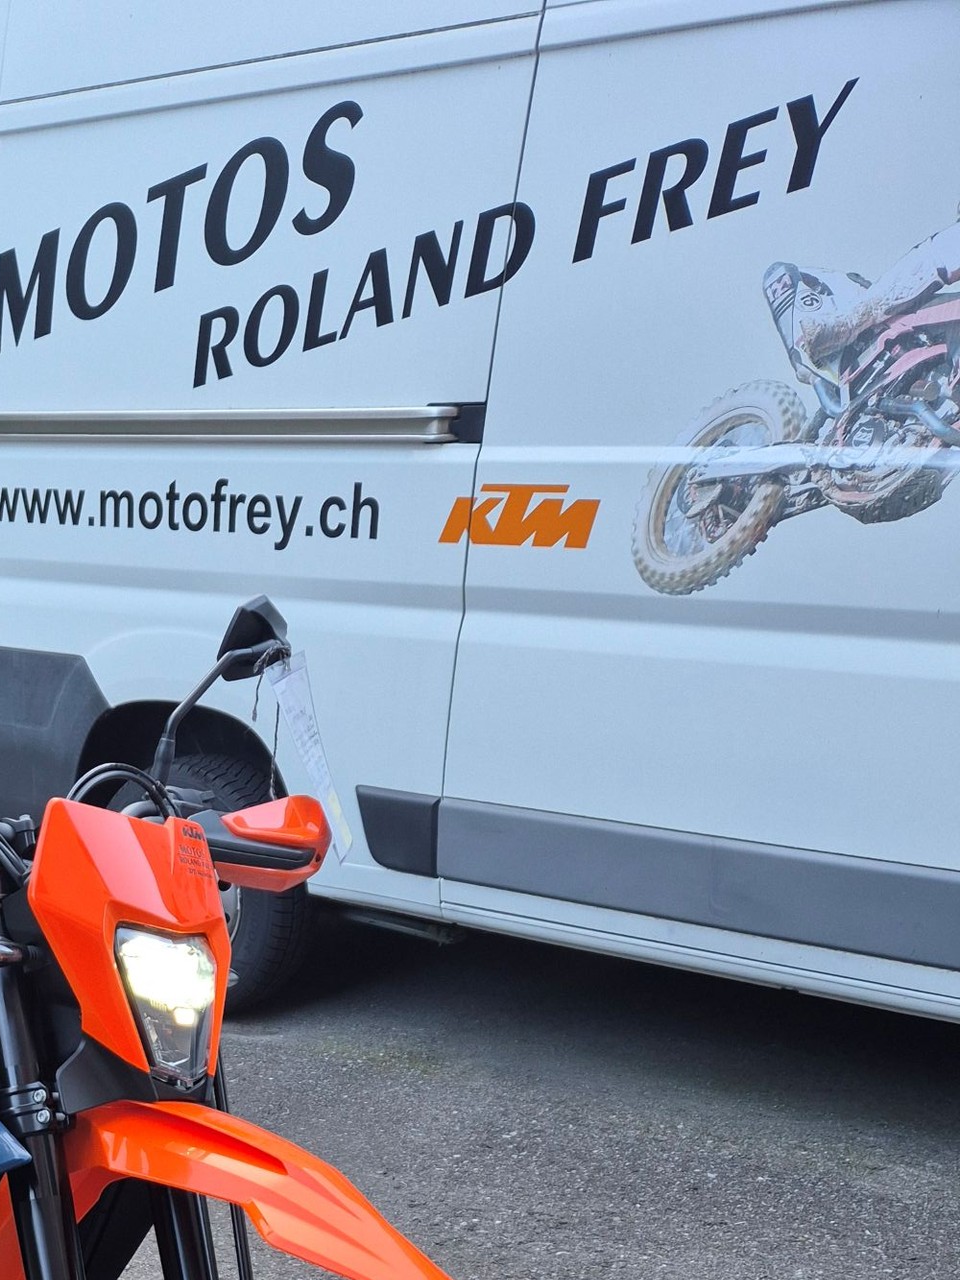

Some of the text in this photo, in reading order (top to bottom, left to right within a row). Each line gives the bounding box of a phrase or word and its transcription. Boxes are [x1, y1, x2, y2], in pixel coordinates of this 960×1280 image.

[193, 77, 860, 389] ROLAND FREY
[438, 483, 601, 549] KTM
